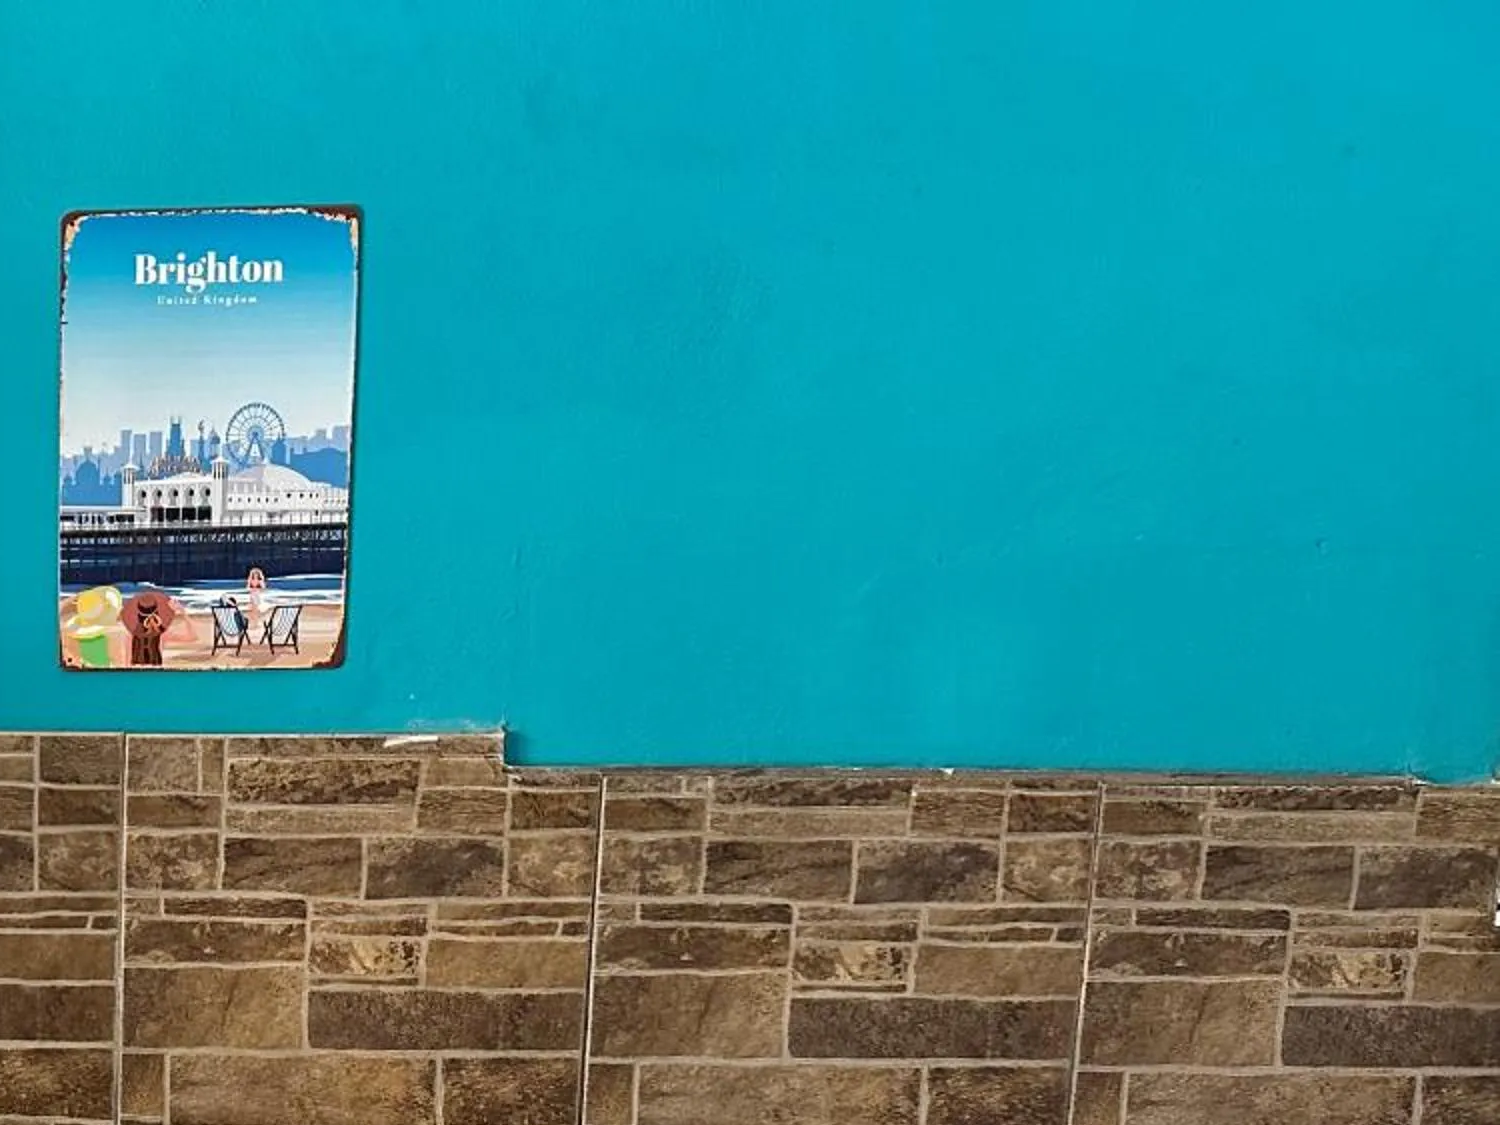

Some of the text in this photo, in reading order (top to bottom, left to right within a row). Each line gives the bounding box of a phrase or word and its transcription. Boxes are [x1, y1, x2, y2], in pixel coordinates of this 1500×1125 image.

[134, 251, 284, 294] Brighton
[157, 294, 258, 308] United Kingdom
